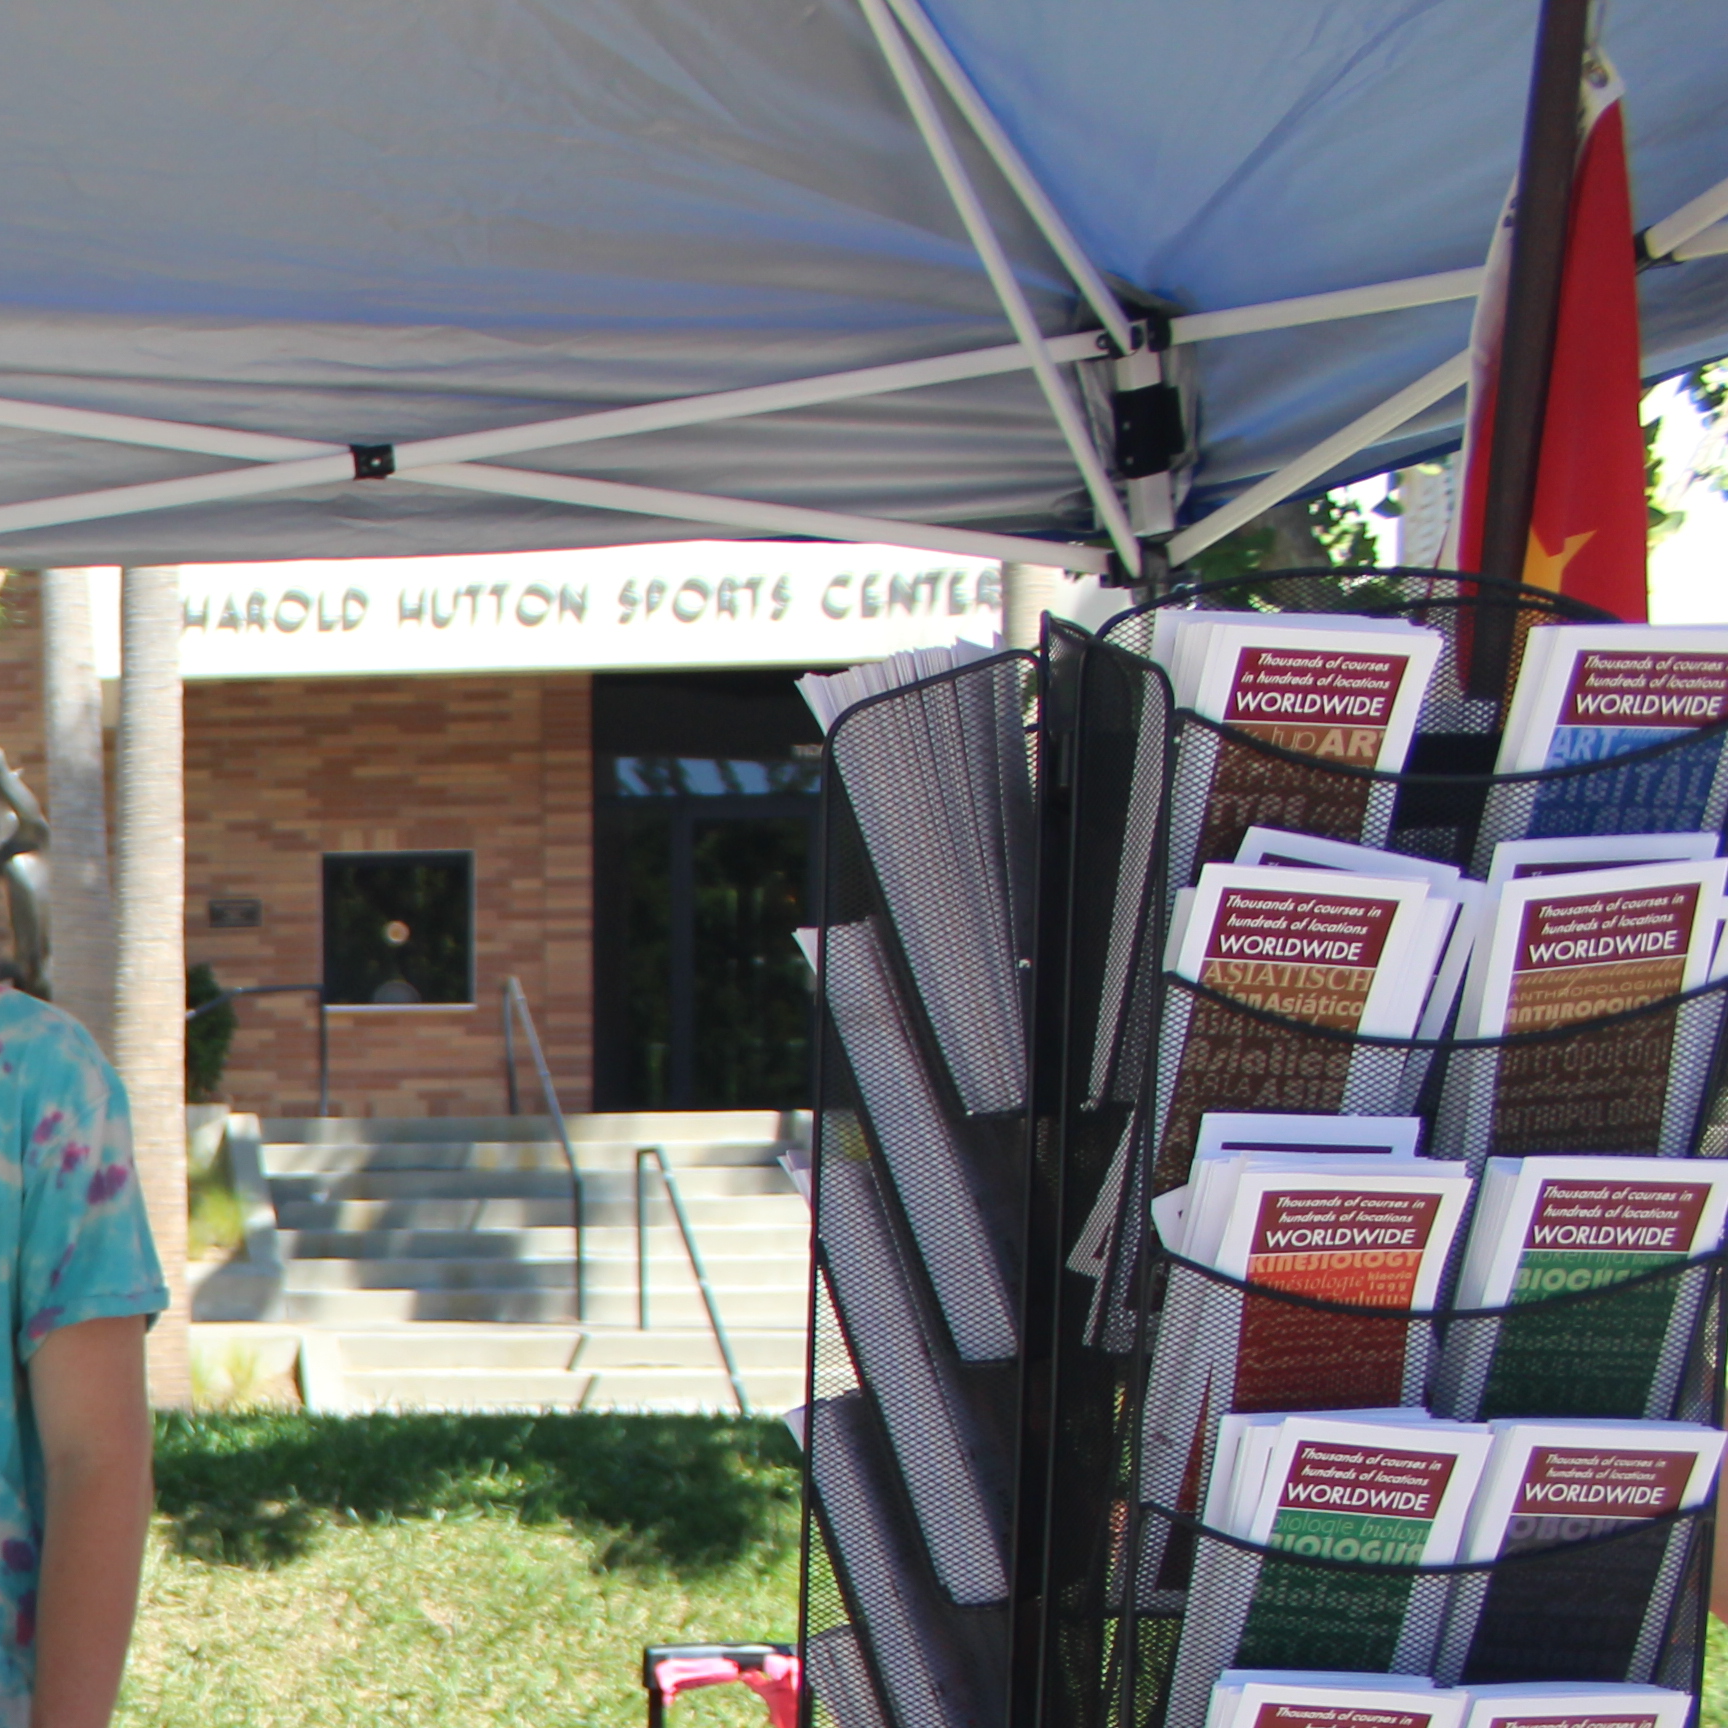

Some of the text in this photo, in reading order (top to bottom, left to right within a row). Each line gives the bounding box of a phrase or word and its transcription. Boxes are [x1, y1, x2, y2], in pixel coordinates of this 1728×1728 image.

[182, 566, 1003, 634] HAROLD HUTTON SPORTS CENTER
[1258, 653, 1389, 671] Thousands of courses
[1241, 671, 1390, 689] in hundreds of locations
[1236, 691, 1385, 716] WORLDWIDE
[1576, 693, 1722, 716] WORLDWIDE
[1226, 895, 1382, 918] Thousands of courses in
[1539, 894, 1684, 917] Thousands of courses in
[1227, 915, 1367, 935] hundreds of locations
[1542, 913, 1673, 935] hundreds of locations
[1219, 934, 1364, 961] WORLDWIDE
[1529, 930, 1678, 963] WORLDWIDE
[1263, 989, 1365, 1016] Asiático
[1276, 1196, 1425, 1209] Thousands of courses in
[1279, 1211, 1413, 1223] hundreds of locations
[1266, 1228, 1417, 1248] WORLDWIDE
[1533, 1225, 1677, 1245] WORLDWIDE
[1287, 1483, 1430, 1511] WORLDWIDE
[1525, 1483, 1665, 1505] WORLDWIDE
